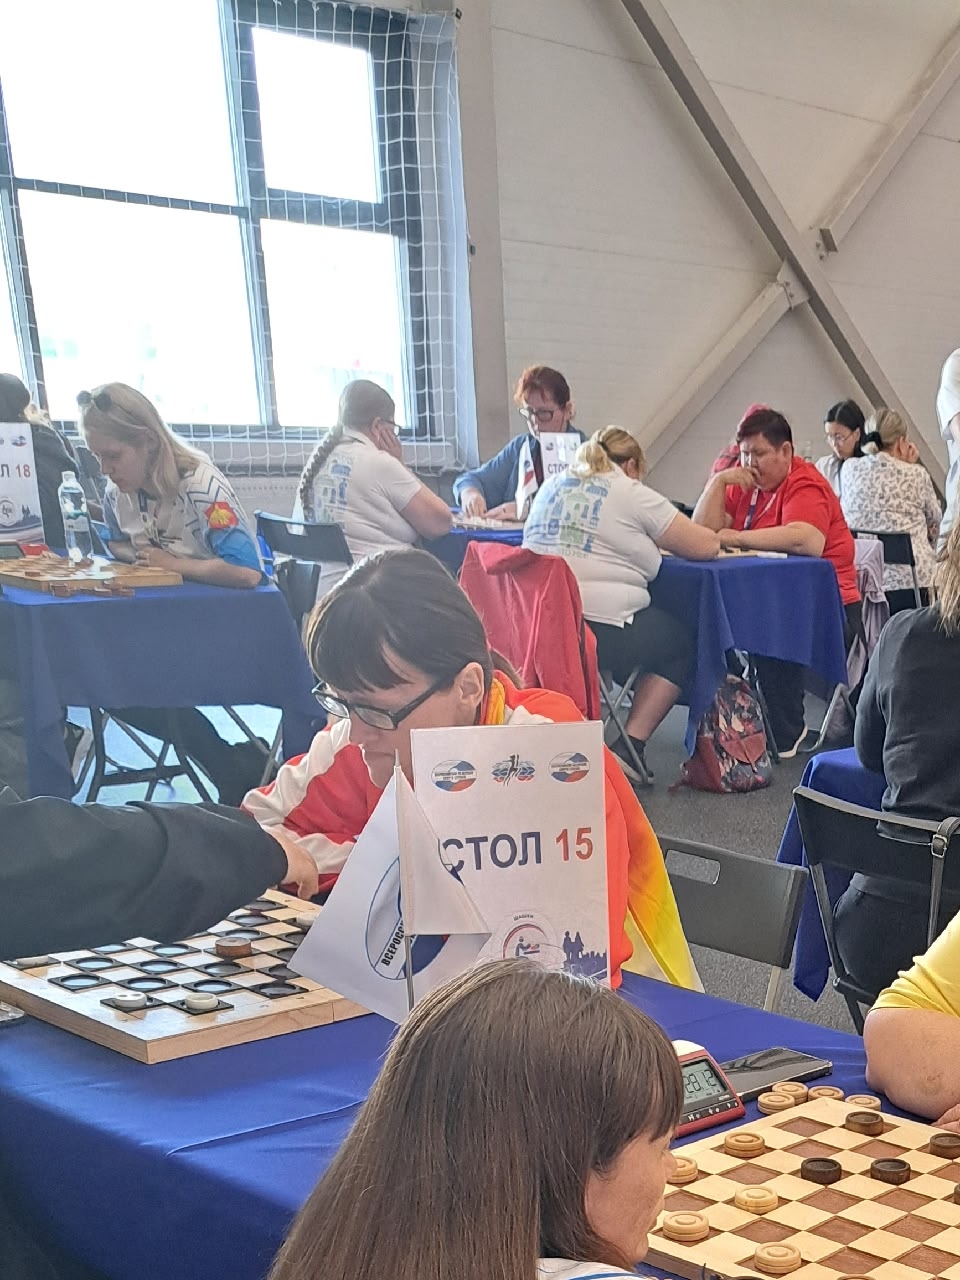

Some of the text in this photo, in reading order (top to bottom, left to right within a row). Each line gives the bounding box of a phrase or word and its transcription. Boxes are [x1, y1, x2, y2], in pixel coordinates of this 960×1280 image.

[16, 464, 31, 478] 18
[442, 827, 594, 873] СТОЛ 15
